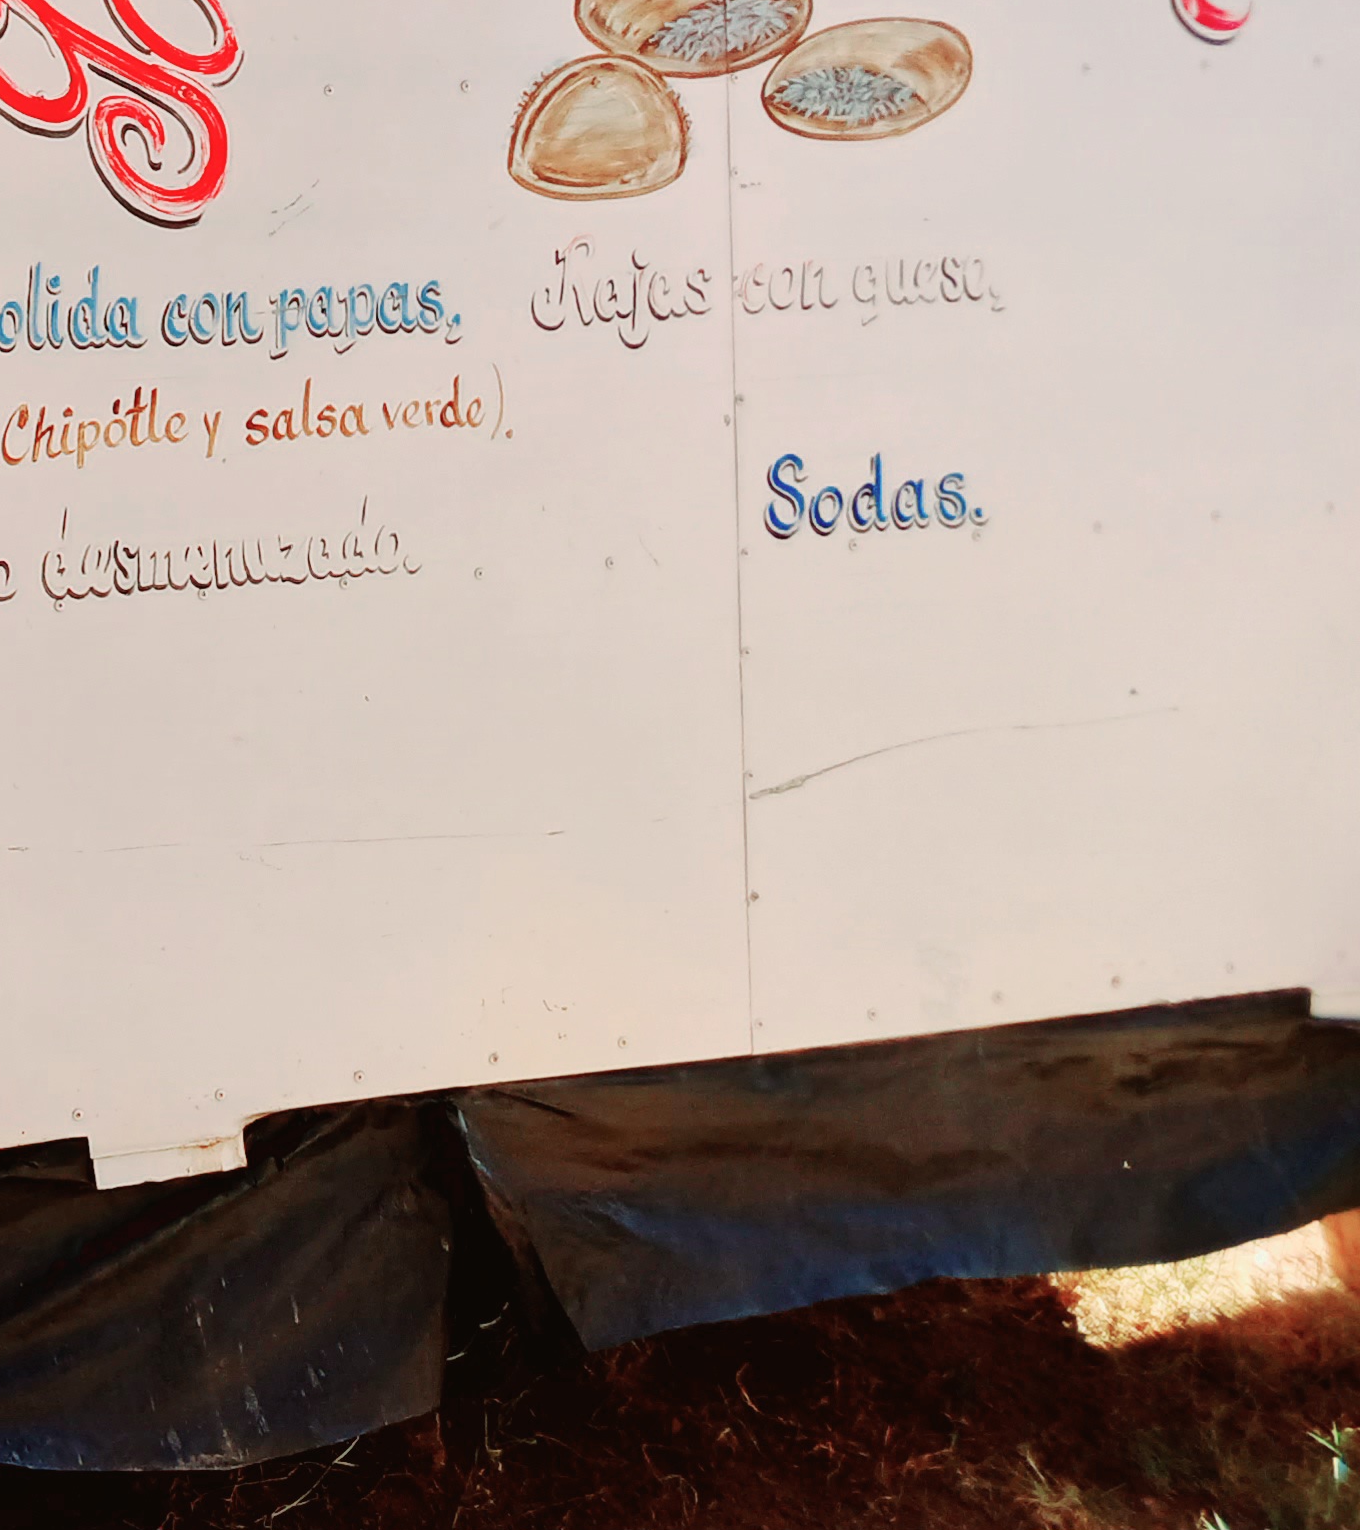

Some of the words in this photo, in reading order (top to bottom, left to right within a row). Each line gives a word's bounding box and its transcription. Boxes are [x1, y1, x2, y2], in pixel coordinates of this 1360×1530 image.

[160, 291, 263, 349] con
[268, 277, 463, 360] papas,
[531, 235, 713, 350] Rajas
[736, 263, 841, 315] con
[203, 408, 224, 459] y
[245, 377, 369, 448] salsa
[764, 451, 990, 540] Sodas.
